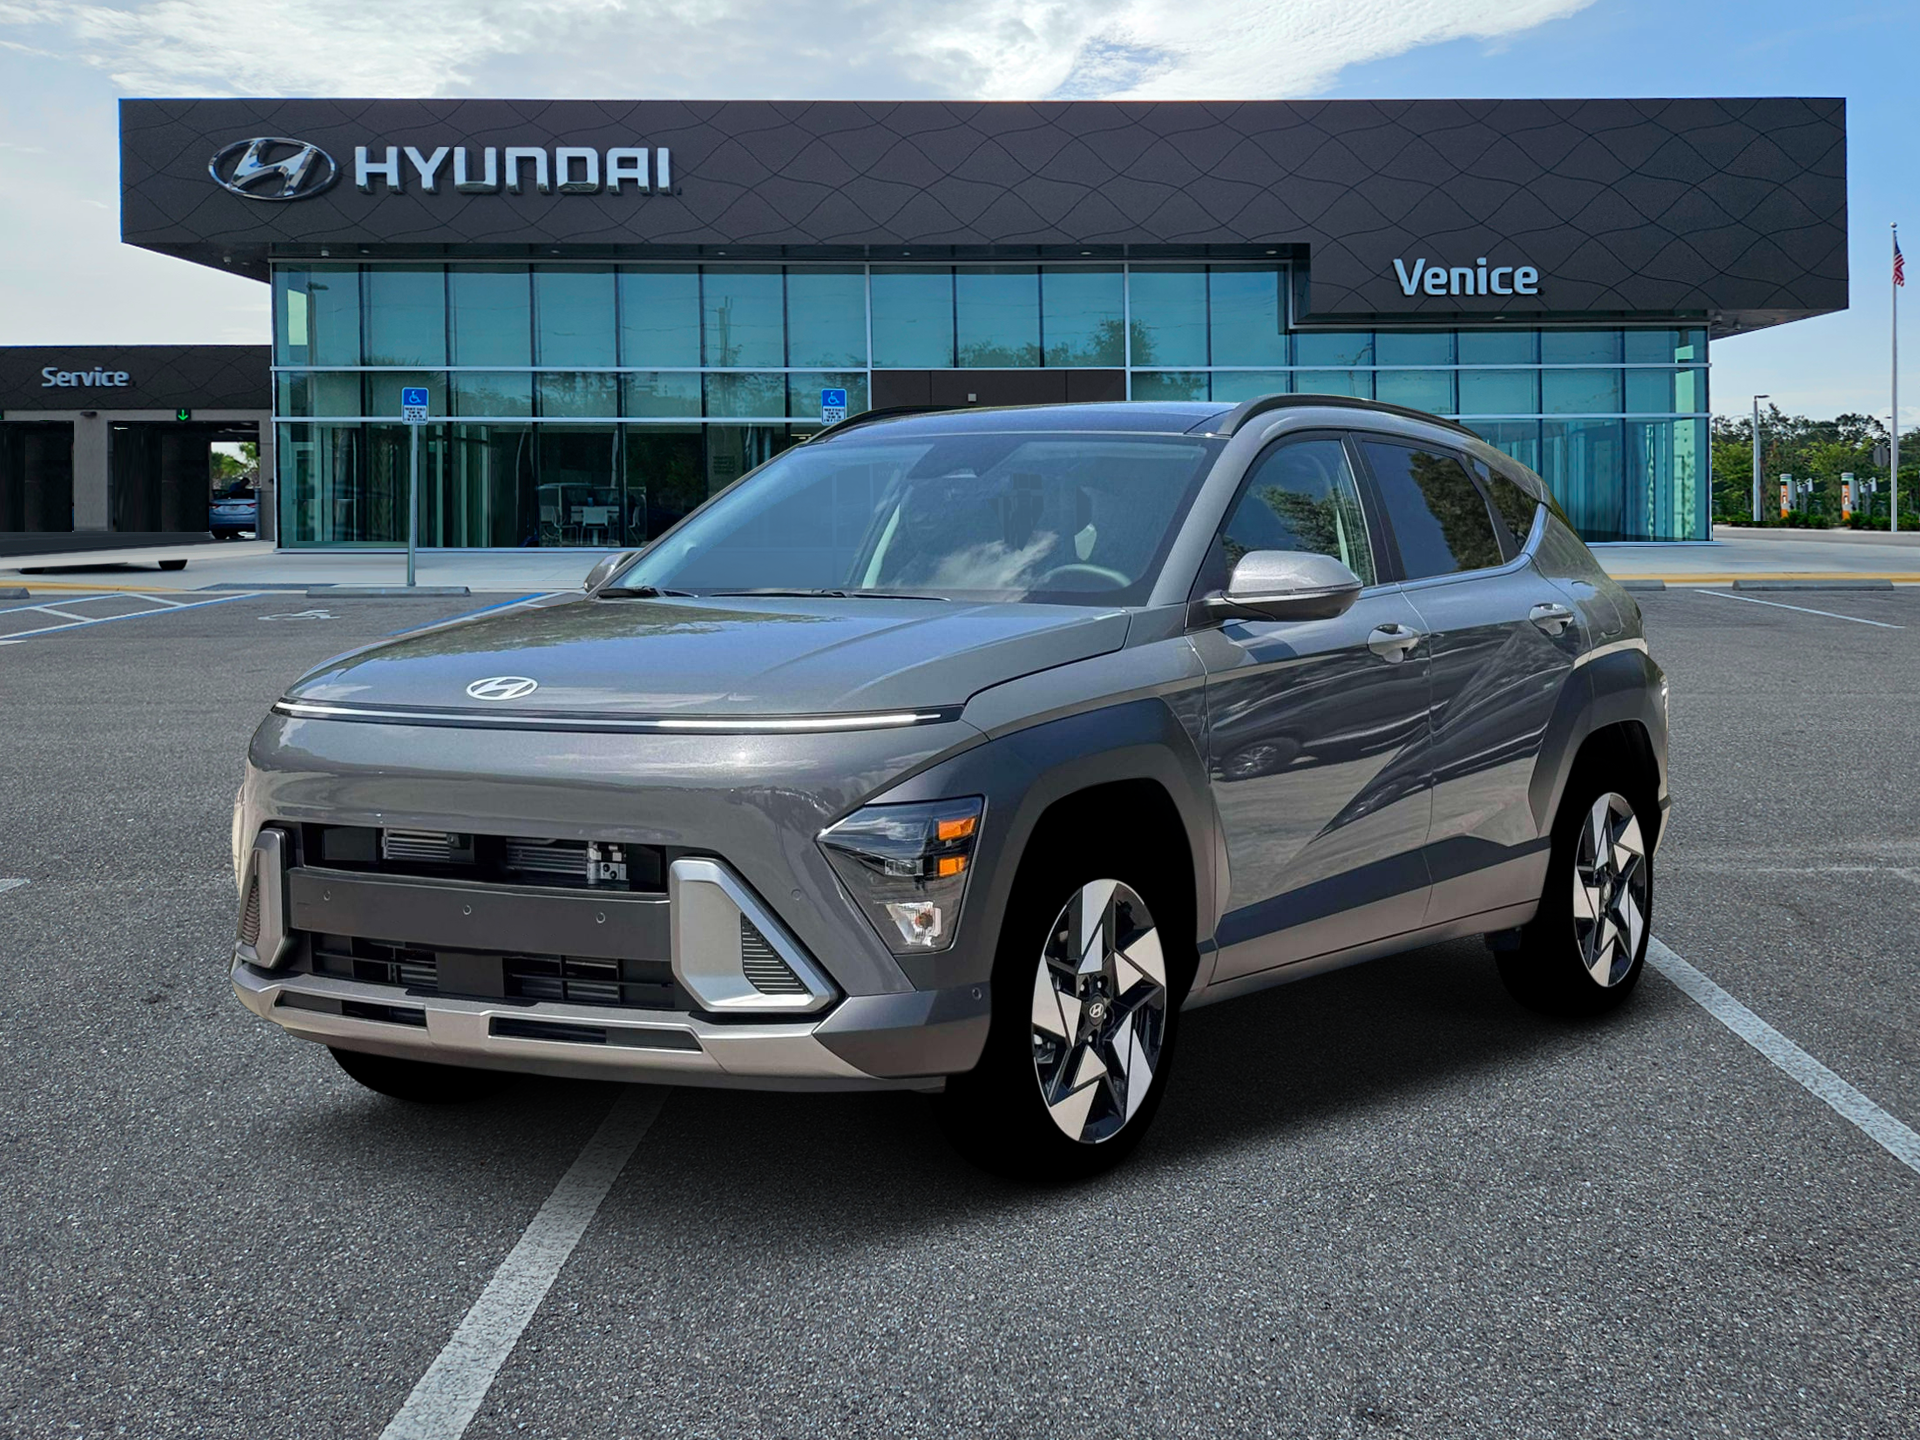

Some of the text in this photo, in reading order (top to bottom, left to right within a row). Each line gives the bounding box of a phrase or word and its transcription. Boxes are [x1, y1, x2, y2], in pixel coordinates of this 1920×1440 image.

[353, 146, 672, 194] HYUNDAI
[1392, 256, 1539, 297] Venice
[40, 366, 130, 388] Service
